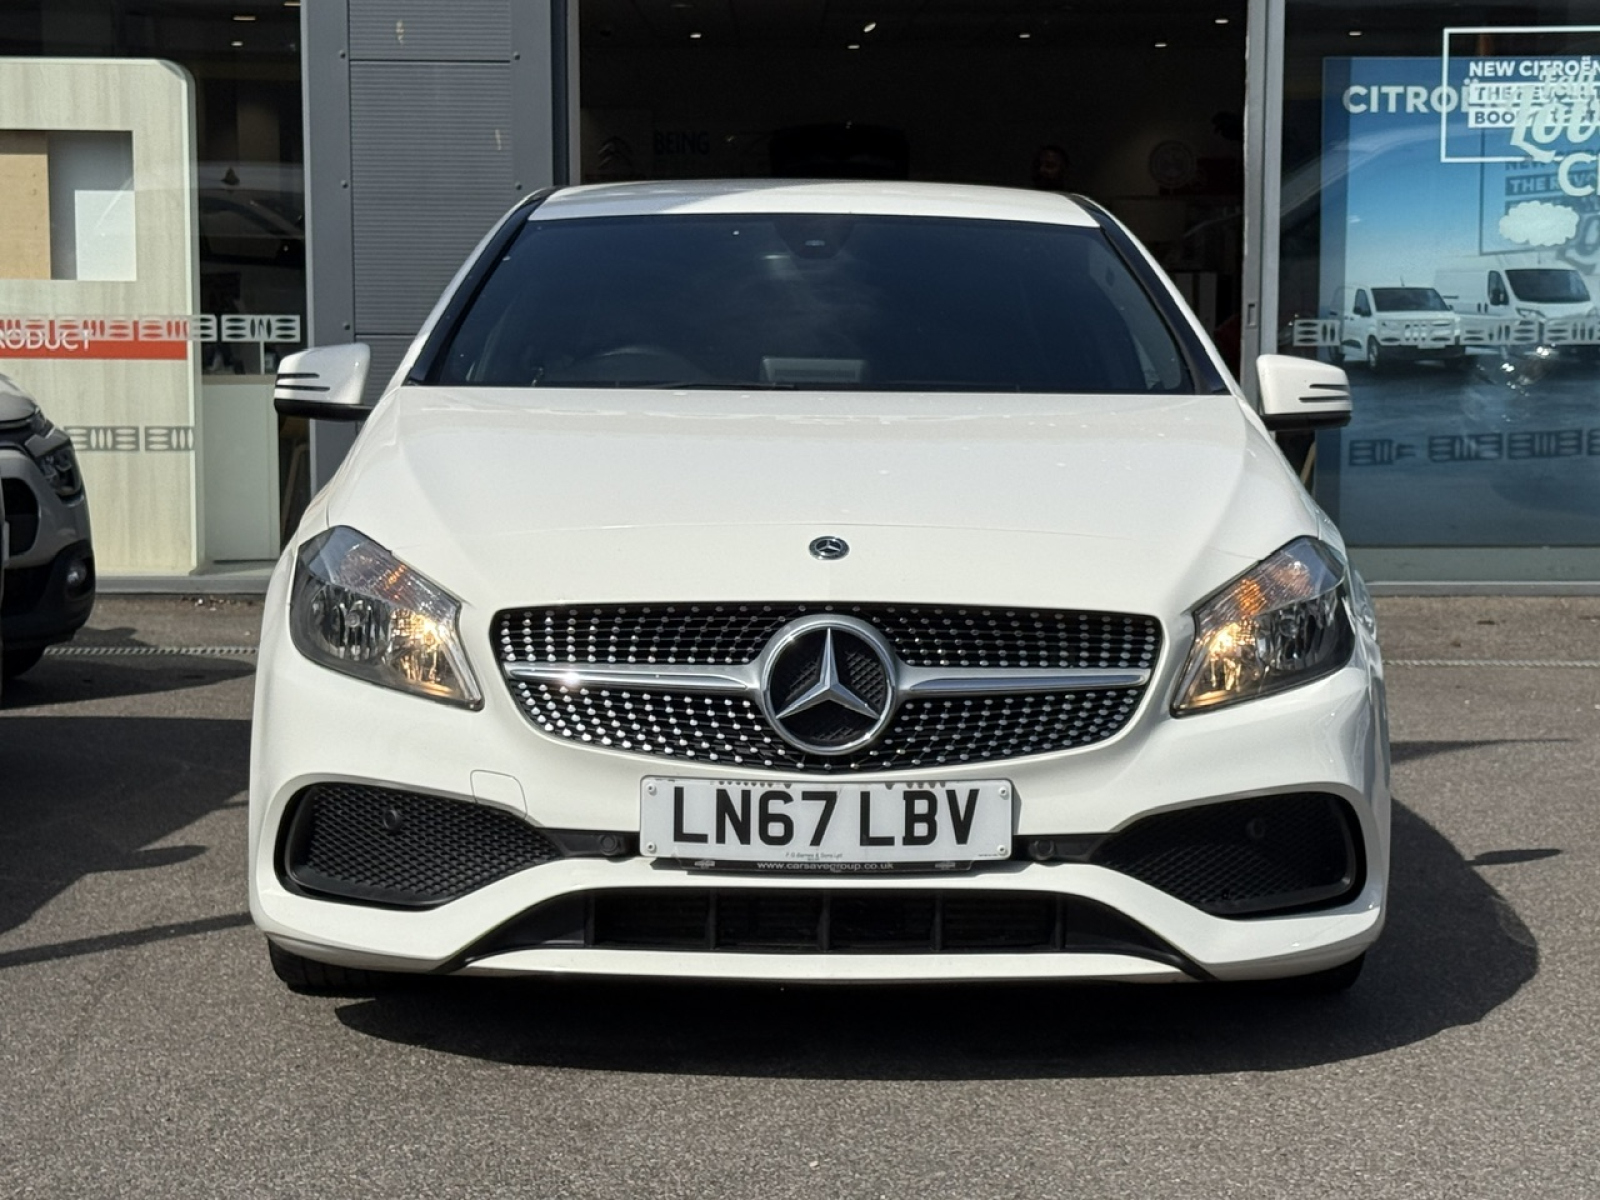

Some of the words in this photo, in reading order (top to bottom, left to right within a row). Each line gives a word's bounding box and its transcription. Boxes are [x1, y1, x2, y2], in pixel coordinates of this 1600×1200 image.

[1469, 60, 1516, 77] NEW
[1475, 111, 1528, 124] BOO
[654, 131, 711, 157] BEING
[673, 787, 838, 847] LN67
[859, 789, 980, 847] LBV
[757, 861, 894, 872] www.carsavegroup.co.uk
